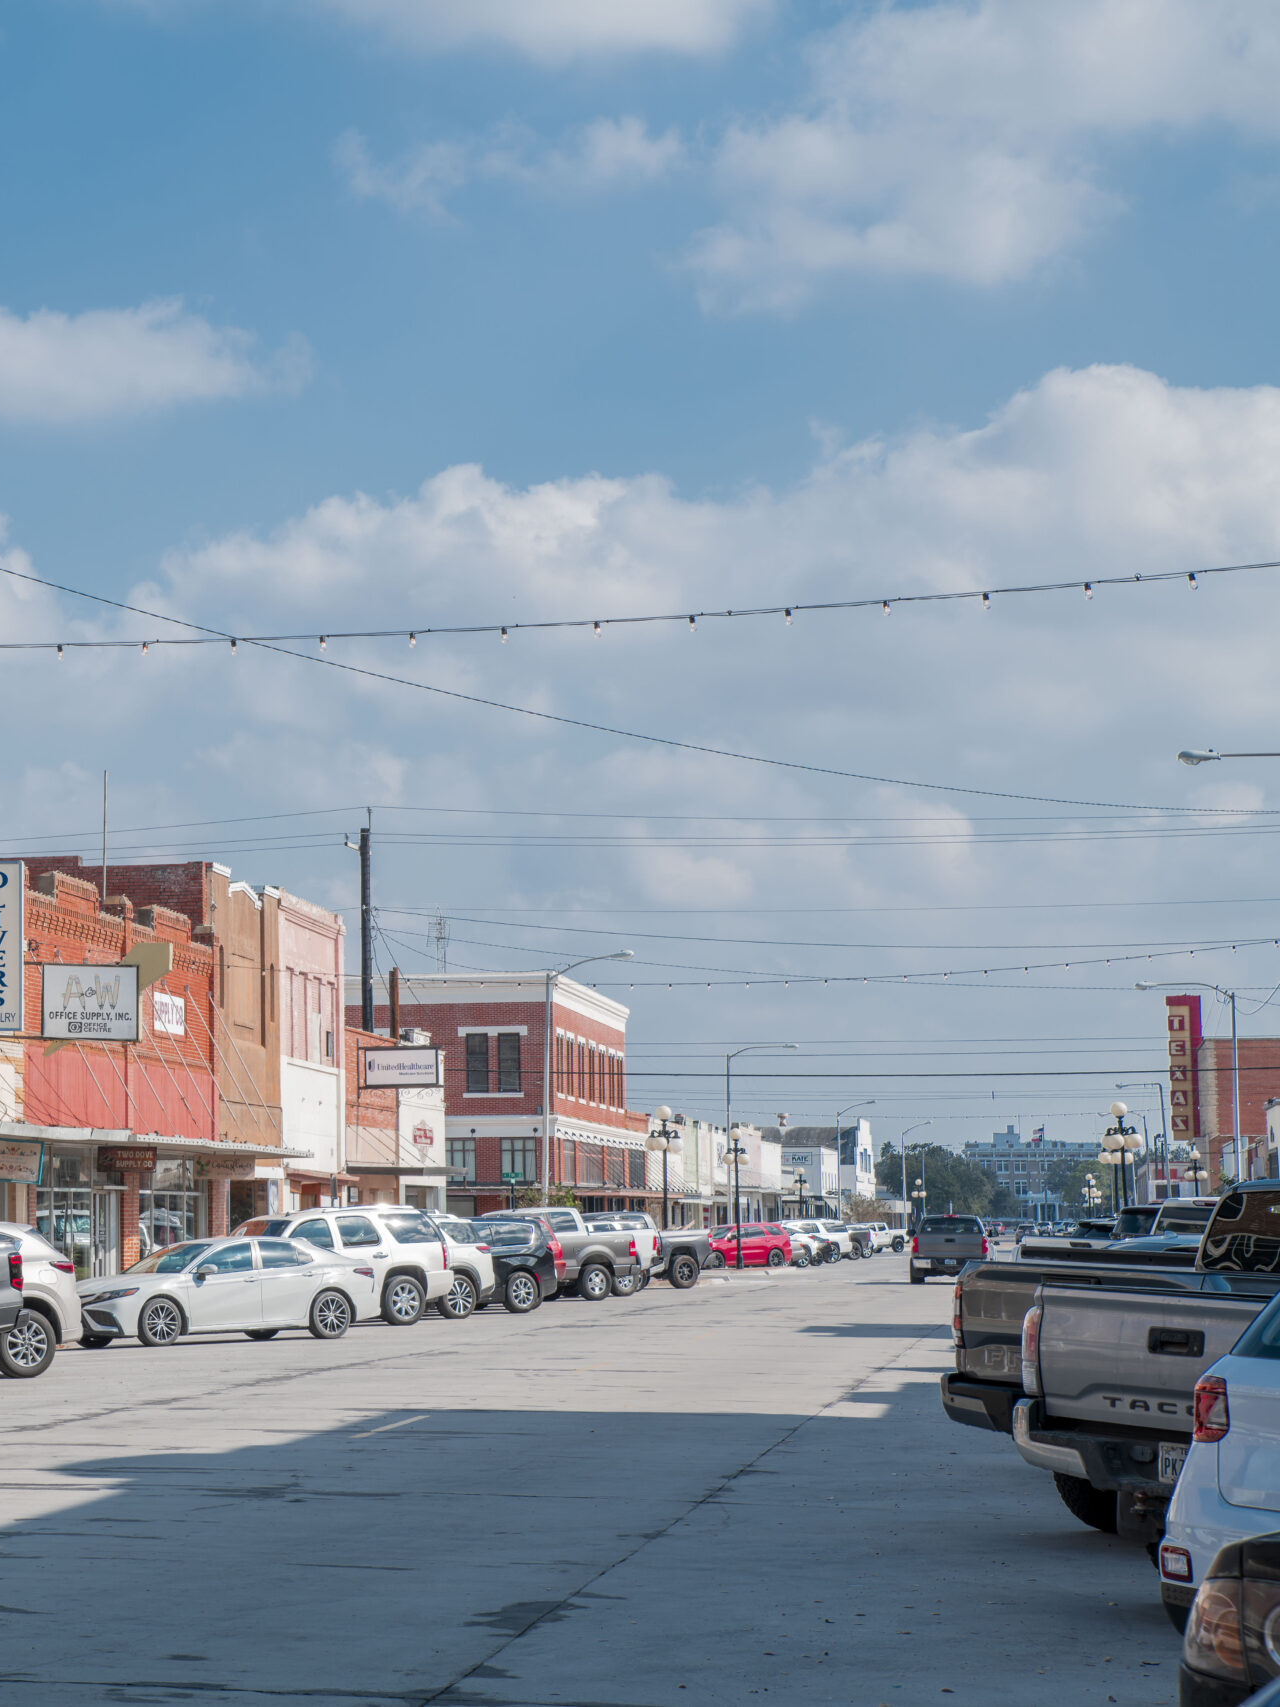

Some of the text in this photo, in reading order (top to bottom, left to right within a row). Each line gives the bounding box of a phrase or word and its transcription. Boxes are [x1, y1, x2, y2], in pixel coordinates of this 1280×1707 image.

[48, 1011, 132, 1021] OFFICE SUPPLY, INC.
[376, 1062, 434, 1071] UnitedHealthcare
[1168, 1016, 1188, 1130] TEXAS
[117, 1150, 154, 1158] TWO DOVE
[116, 1160, 141, 1168] SUPPLY
